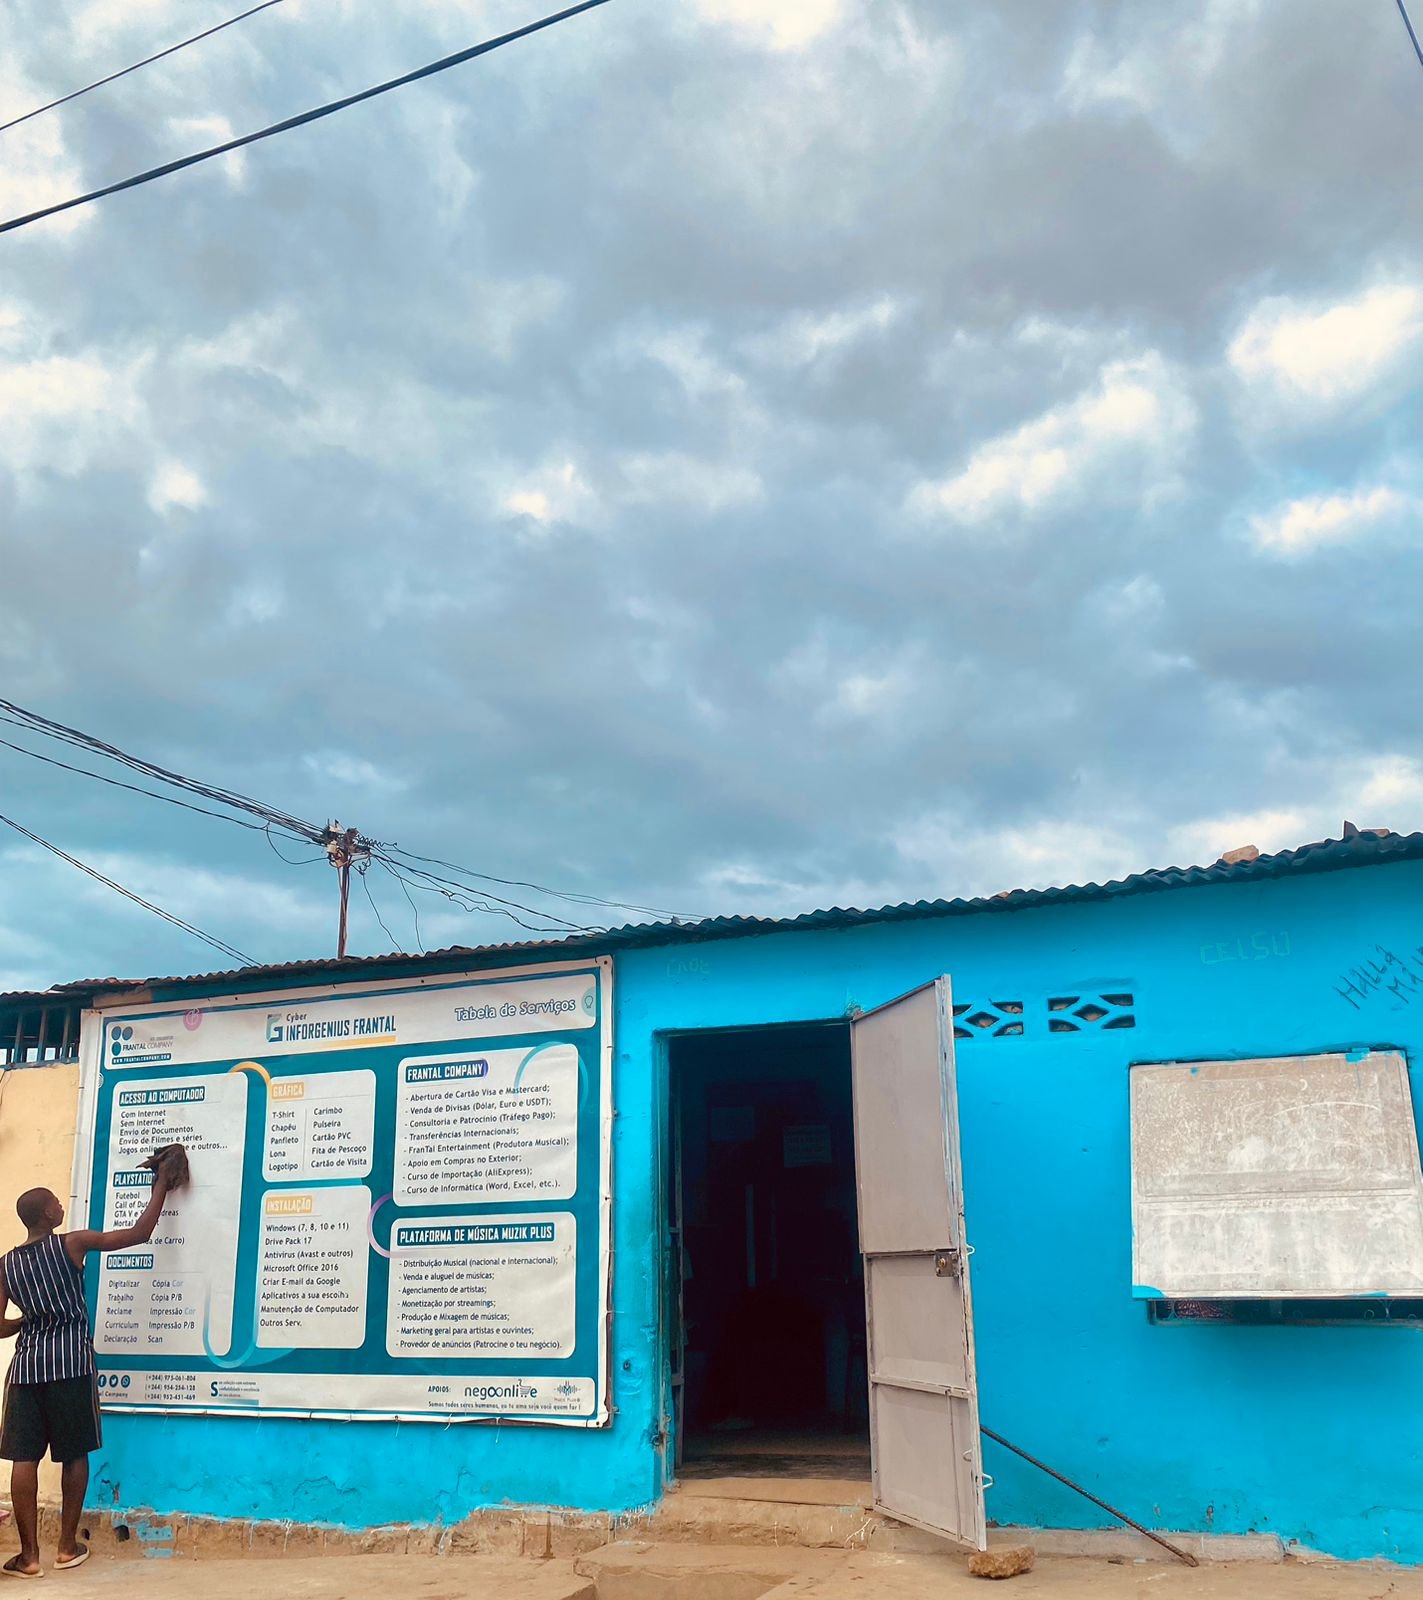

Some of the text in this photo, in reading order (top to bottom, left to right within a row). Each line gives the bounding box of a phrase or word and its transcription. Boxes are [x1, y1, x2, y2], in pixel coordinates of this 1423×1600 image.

[455, 999, 575, 1021] Tabela de Serviços
[286, 1013, 307, 1023] Cyber
[286, 1016, 396, 1041] INFORGENIUS FRANTAL
[123, 1041, 173, 1051] FRANTAL COMPANY
[407, 1063, 483, 1081] FRANTAL COMPANY
[273, 1083, 303, 1097] GRÁFICA
[410, 1093, 442, 1102] Abertura
[455, 1089, 480, 1099] Cartão
[506, 1084, 550, 1094] Mastercard;
[120, 1088, 204, 1104] ACESSO AO COMPUTADOR
[314, 1107, 343, 1115] Carimbo
[410, 1107, 432, 1115] Venda
[434, 1105, 443, 1113] de
[446, 1104, 471, 1112] Divisas
[499, 1101, 517, 1109] Euro
[526, 1098, 552, 1107] USDT);
[120, 1120, 134, 1128] Sem
[313, 1120, 341, 1128] Pulseira
[410, 1119, 451, 1127] Consultoria
[499, 1114, 530, 1122] (Tráfego
[532, 1111, 556, 1120] Pago);
[120, 1128, 139, 1136] Envio
[152, 1126, 194, 1135] Documentos
[271, 1124, 296, 1133] Chapéu
[312, 1134, 335, 1142] Cartão
[409, 1128, 519, 1141] Transferências Internacionais;
[151, 1136, 174, 1144] Filmes
[271, 1137, 299, 1145] Panfleto
[119, 1146, 138, 1155] Jogos
[338, 1145, 366, 1153] Pescoço
[408, 1137, 569, 1154] FranTal Entertainment (Produtora Musical);
[269, 1163, 298, 1172] Logotipo
[311, 1160, 334, 1168] Cartão
[115, 1172, 156, 1185] PLAYSTATIO
[407, 1172, 428, 1181] Curso
[441, 1169, 483, 1179] Importação
[485, 1168, 533, 1177] (AliExpress);
[267, 1198, 311, 1212] INSTALAÇÃO
[114, 1210, 127, 1218] GTA
[266, 1224, 296, 1232] Windows
[298, 1224, 308, 1232] (7,
[310, 1223, 317, 1232] 8,
[338, 1222, 349, 1231] 11)
[400, 1226, 552, 1243] PLATAFORMA DE MÚSICA MUZIK PLUS
[154, 1237, 163, 1245] de
[164, 1236, 185, 1245] Carro)
[297, 1250, 319, 1259] (Avast
[328, 1249, 353, 1258] outros)
[107, 1255, 152, 1268] DOCUMENTOS
[403, 1256, 559, 1268] Distribuição Musical (nacional internacional);
[264, 1264, 295, 1272] Microsoft
[109, 1280, 140, 1289] Digitalizar
[152, 1280, 170, 1289] Cópia
[316, 1277, 340, 1286] Google
[402, 1286, 448, 1296] Agenciamento
[460, 1285, 487, 1294] artistas;
[108, 1294, 134, 1302] Trabalho
[151, 1293, 182, 1303] Cópia P/B
[262, 1292, 298, 1300] Aplicativos
[401, 1299, 496, 1309] Monetização por streamings;
[150, 1307, 196, 1317] Impressão Cor
[261, 1306, 302, 1314] Manutenção
[315, 1305, 359, 1314] Computador
[149, 1321, 195, 1330] Impressão P/B
[260, 1319, 302, 1327] Outros Serv.
[400, 1326, 534, 1336] Marketing geral para artistas ouvintes;
[104, 1335, 138, 1344] Declaração
